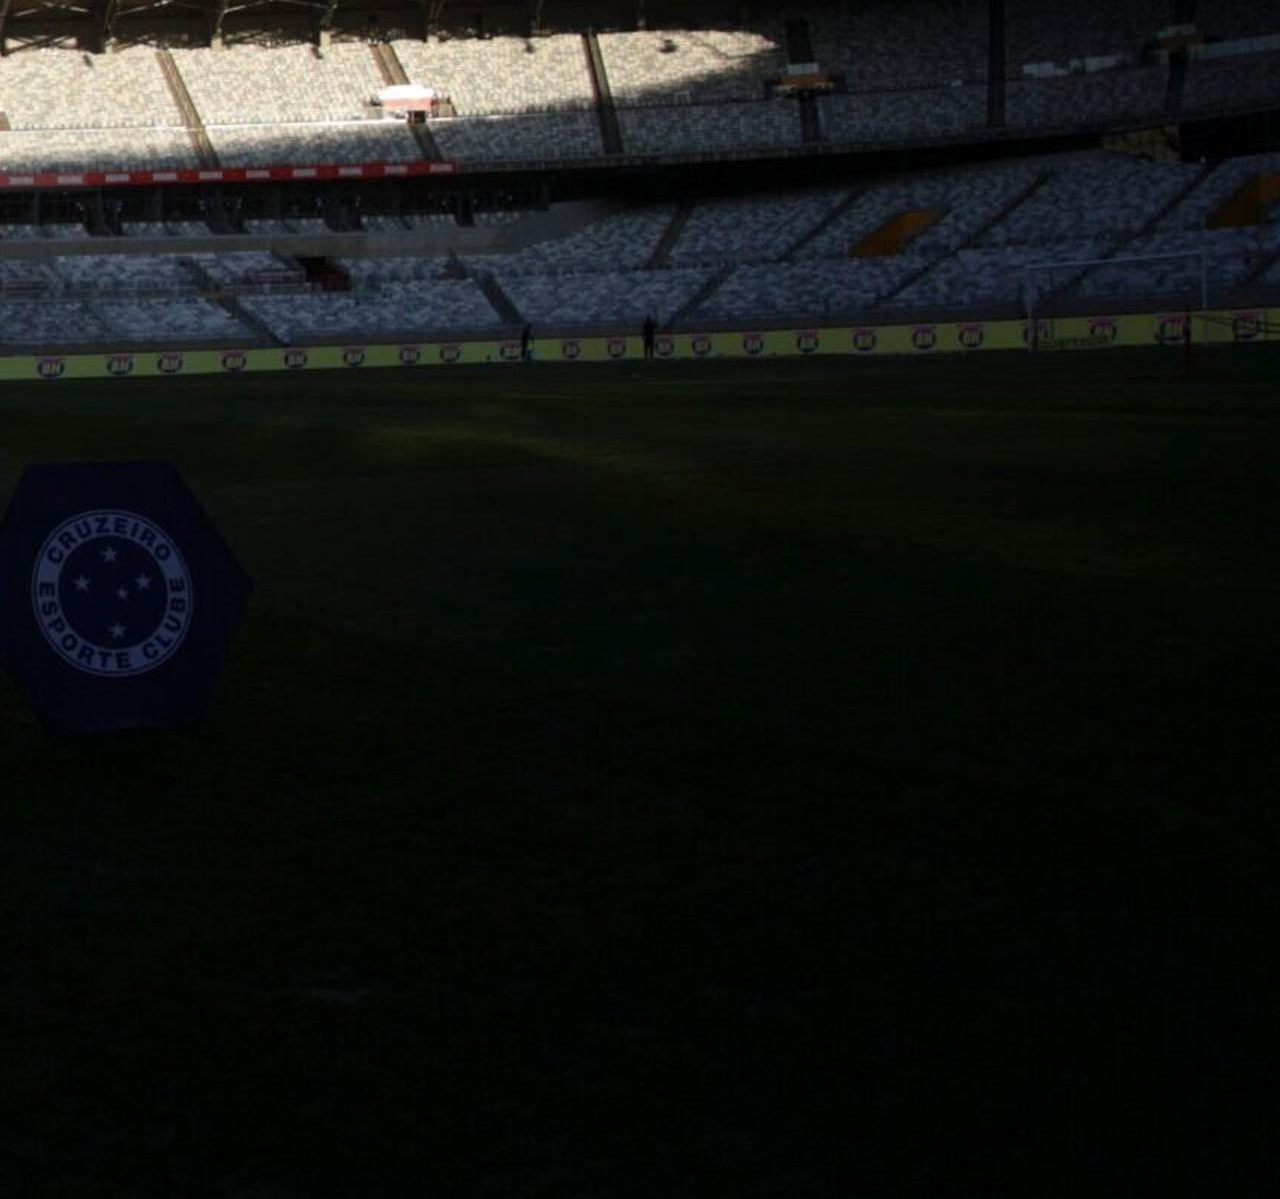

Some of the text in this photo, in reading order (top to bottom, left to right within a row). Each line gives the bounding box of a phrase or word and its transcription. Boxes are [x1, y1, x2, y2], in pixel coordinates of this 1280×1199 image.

[48, 517, 170, 563] CRUZEIRO
[40, 578, 185, 669] ESPORTE CLUBE
